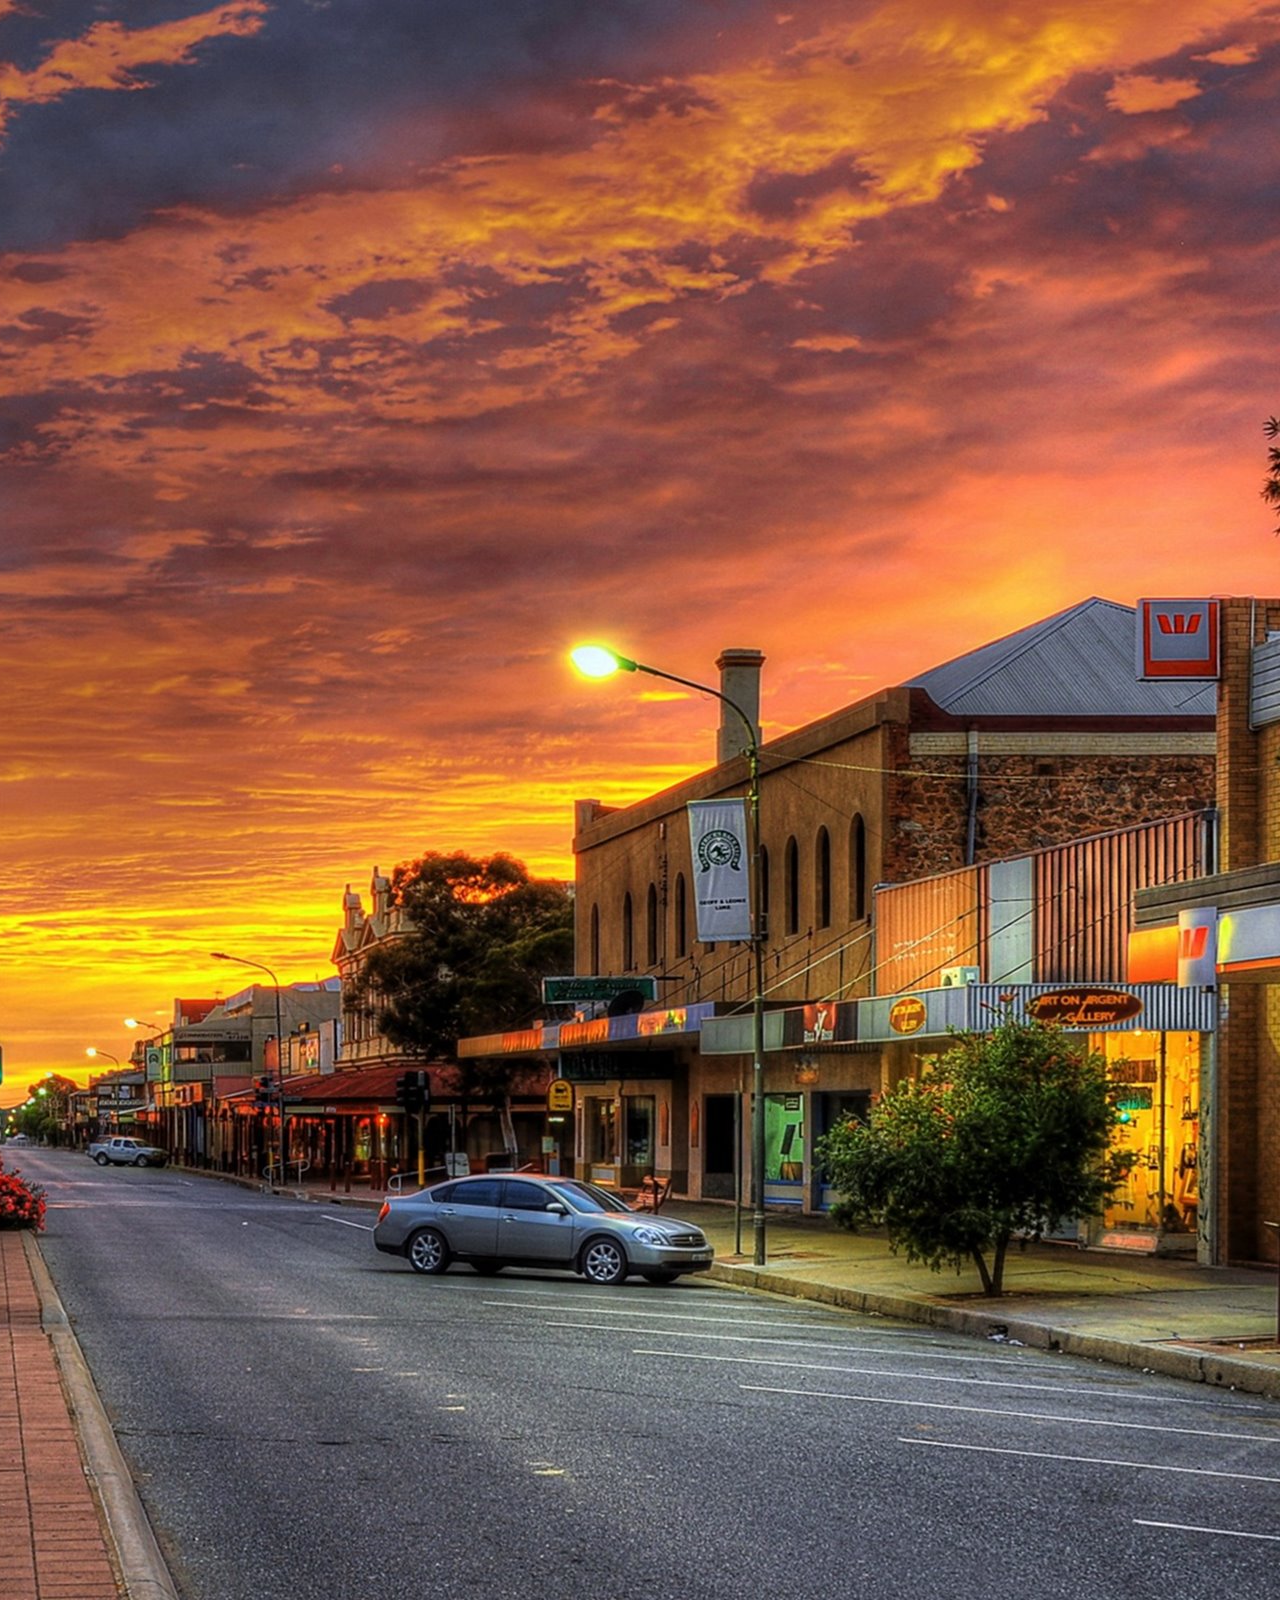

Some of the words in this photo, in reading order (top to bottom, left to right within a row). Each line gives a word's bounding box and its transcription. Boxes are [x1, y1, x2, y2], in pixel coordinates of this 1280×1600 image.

[1038, 996, 1059, 1006] ART
[1060, 996, 1080, 1005] ON
[1082, 995, 1129, 1005] ARGENT
[1065, 1012, 1116, 1022] GALLERY
